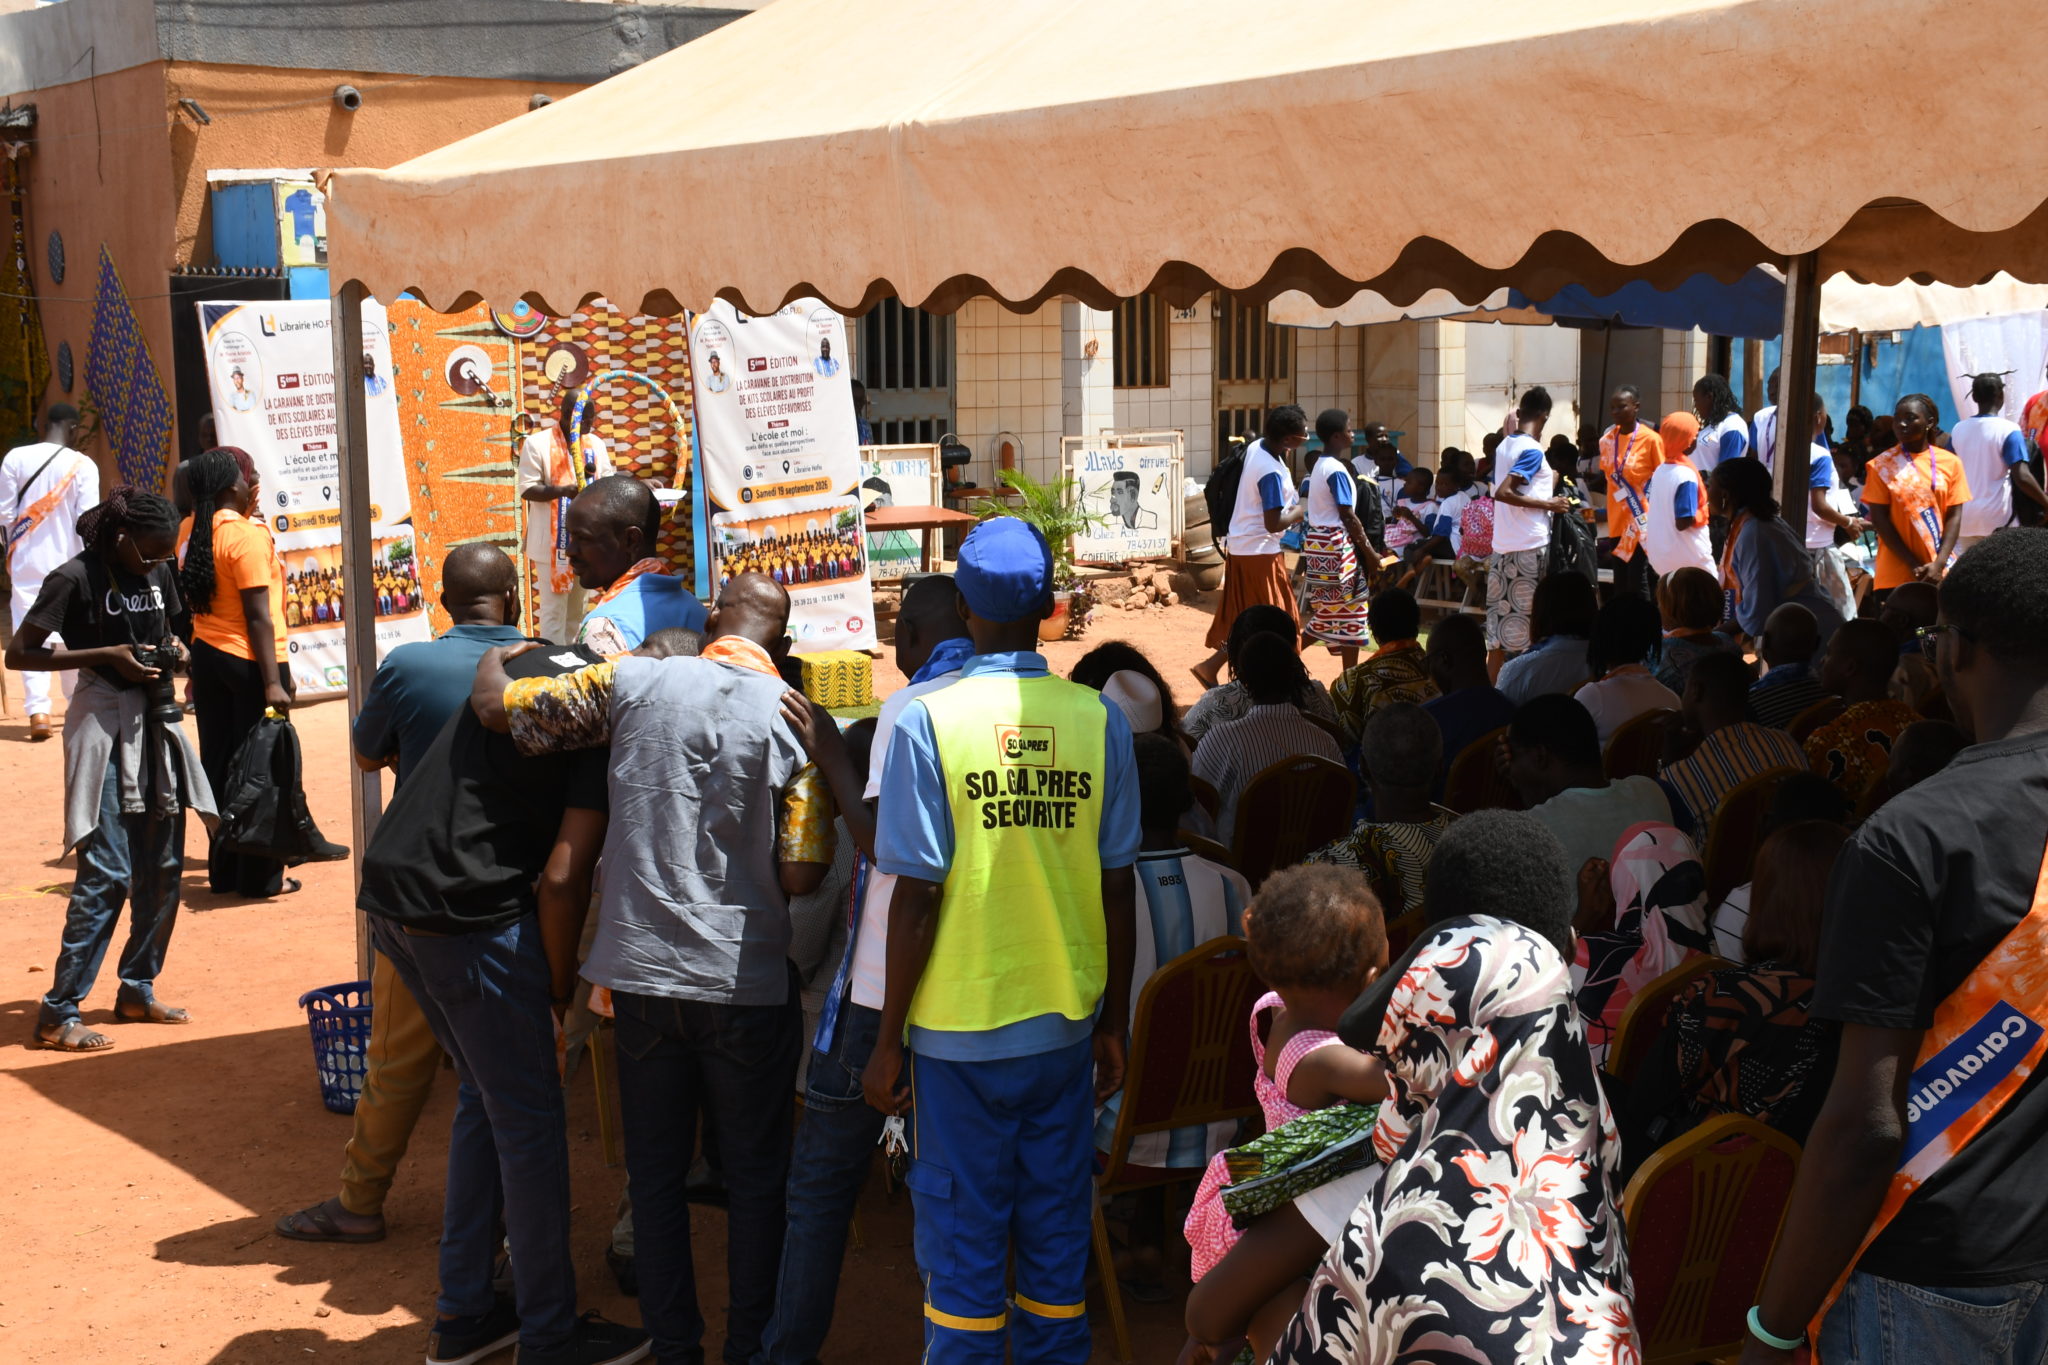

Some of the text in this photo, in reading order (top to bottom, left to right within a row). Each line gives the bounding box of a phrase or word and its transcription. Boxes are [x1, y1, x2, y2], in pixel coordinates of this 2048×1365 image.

[280, 319, 332, 332] Librairie HO.F
[769, 355, 799, 369] ÉDITION
[303, 372, 336, 387] ÉDITION
[736, 372, 815, 391] LA CARAVANE DE DISTRIBUTION
[264, 392, 336, 410] LA CARAVANE DE DISTRI
[739, 386, 815, 405] DE KITS SCOLAIRES AU PROFIT
[267, 409, 335, 425] DE KITS SCOLAIRES AU
[745, 408, 757, 419] DES
[275, 428, 289, 440] DES
[314, 422, 337, 436] DÉFAVO
[752, 430, 779, 442] L'école
[781, 429, 789, 439] et
[790, 427, 804, 437] moi
[284, 453, 316, 466] L'école
[318, 452, 327, 462] et
[755, 487, 777, 499] Samedi
[777, 486, 785, 496] 19
[785, 483, 815, 496] septembre
[292, 514, 317, 528] Samedi
[318, 513, 326, 525] 19
[326, 513, 341, 526] sept
[1157, 874, 1183, 887] 1893
[1907, 1015, 2028, 1123] Caravane
